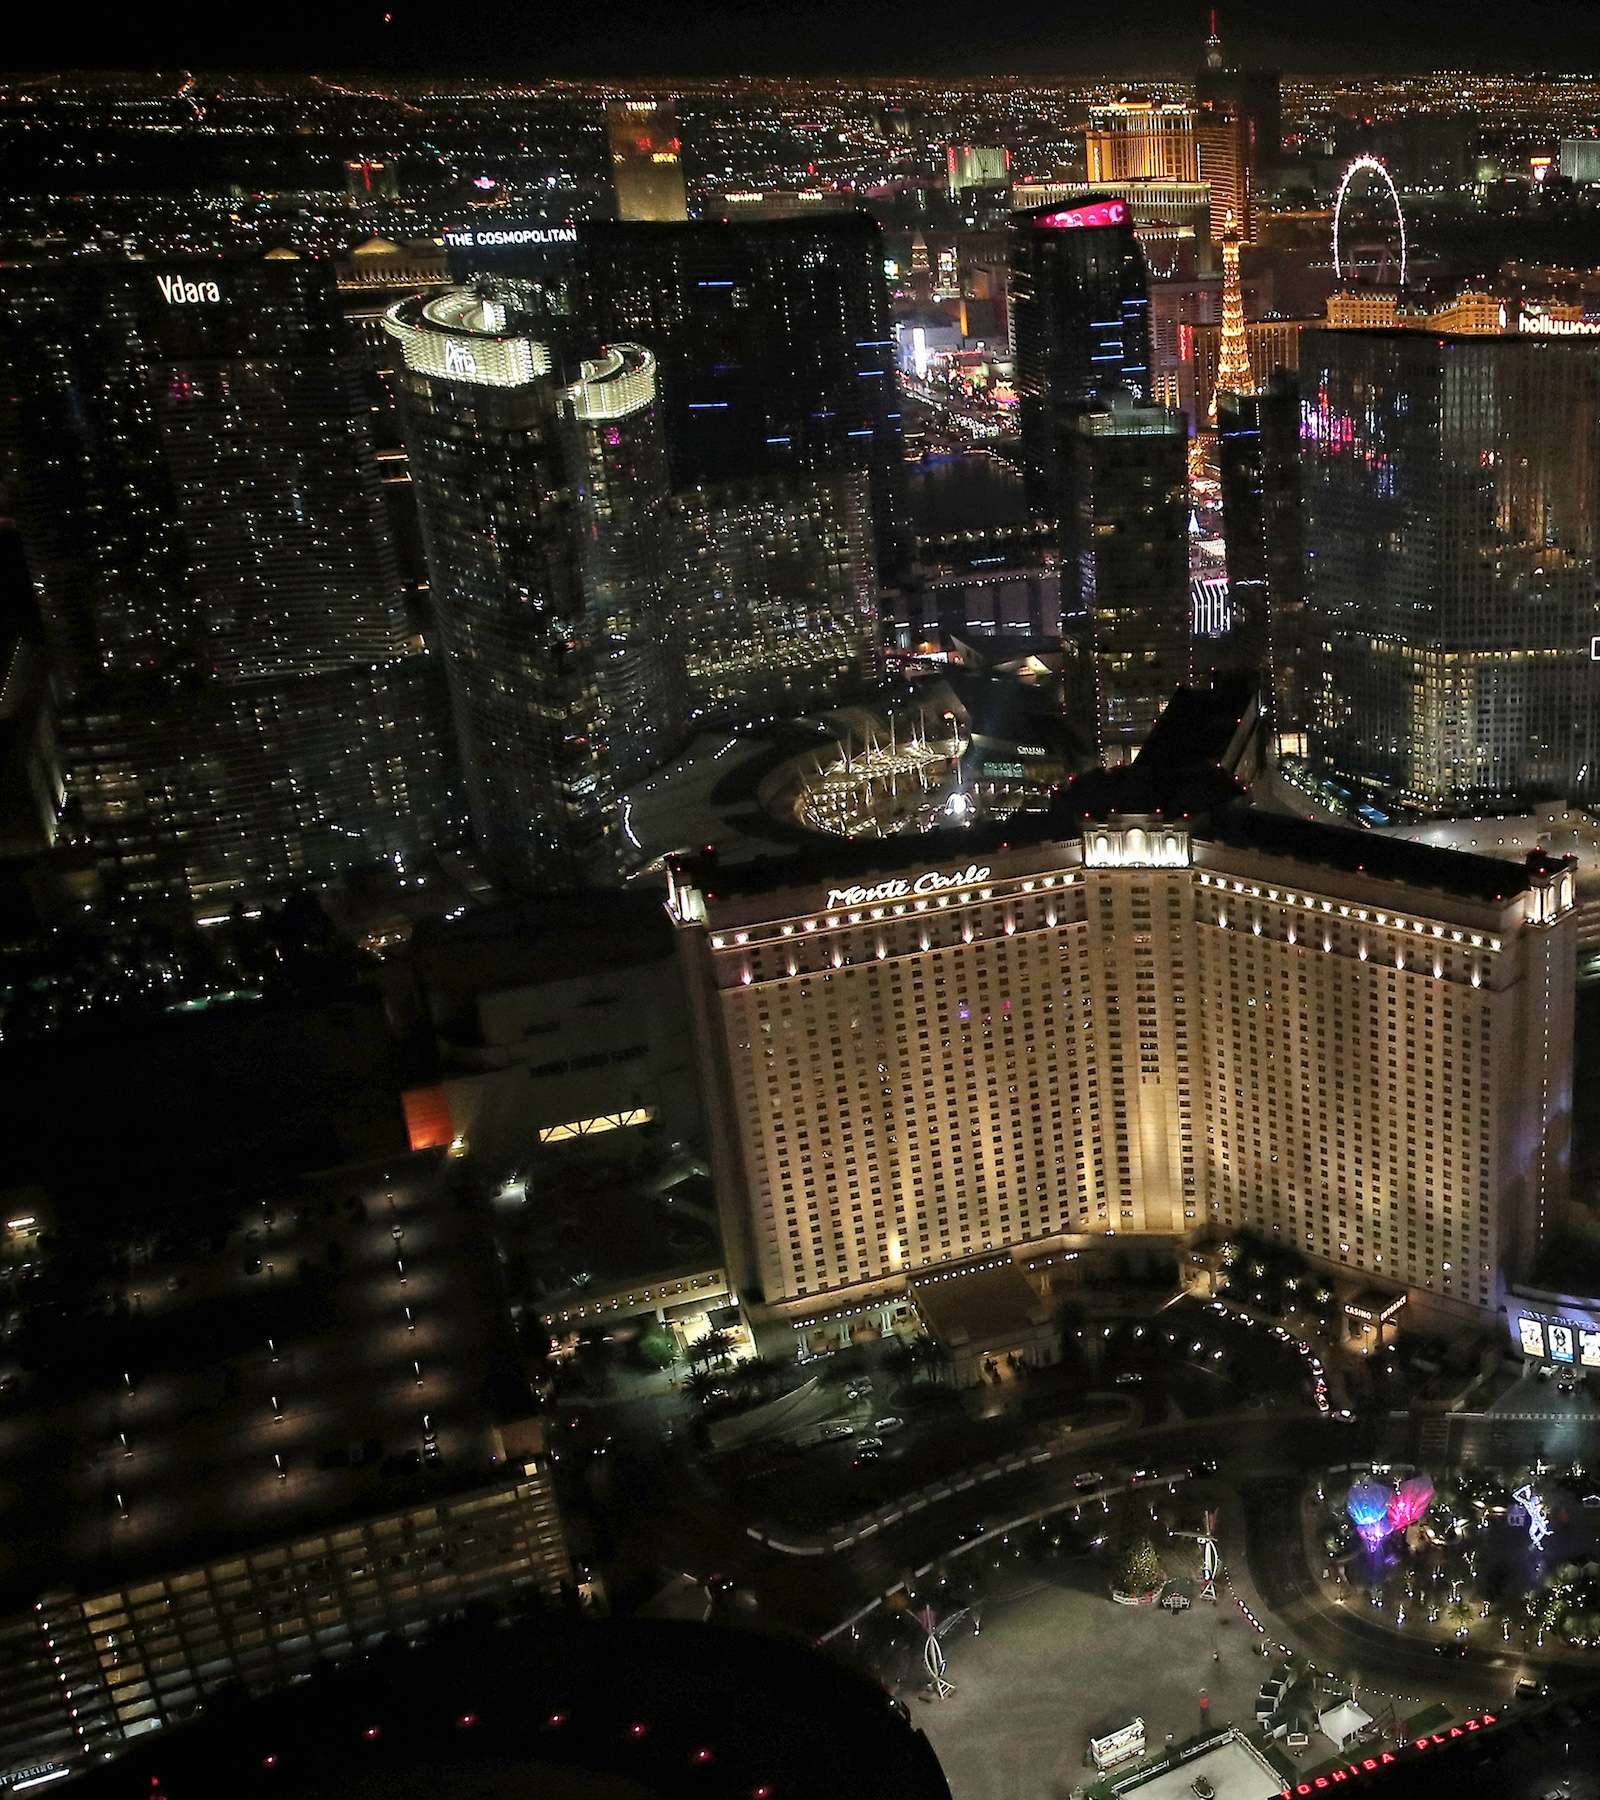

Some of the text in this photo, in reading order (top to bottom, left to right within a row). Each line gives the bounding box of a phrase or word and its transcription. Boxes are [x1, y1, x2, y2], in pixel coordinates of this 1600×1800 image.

[626, 101, 657, 111] TRUMP
[1046, 182, 1089, 191] VENETIAN
[446, 229, 577, 246] THE COSMOPOLITAN
[157, 274, 220, 304] Vdara
[825, 864, 991, 910] Monte Carlo
[1344, 1304, 1373, 1320] CASINO
[1280, 1714, 1497, 1800] TOSHIBA PLAZA
